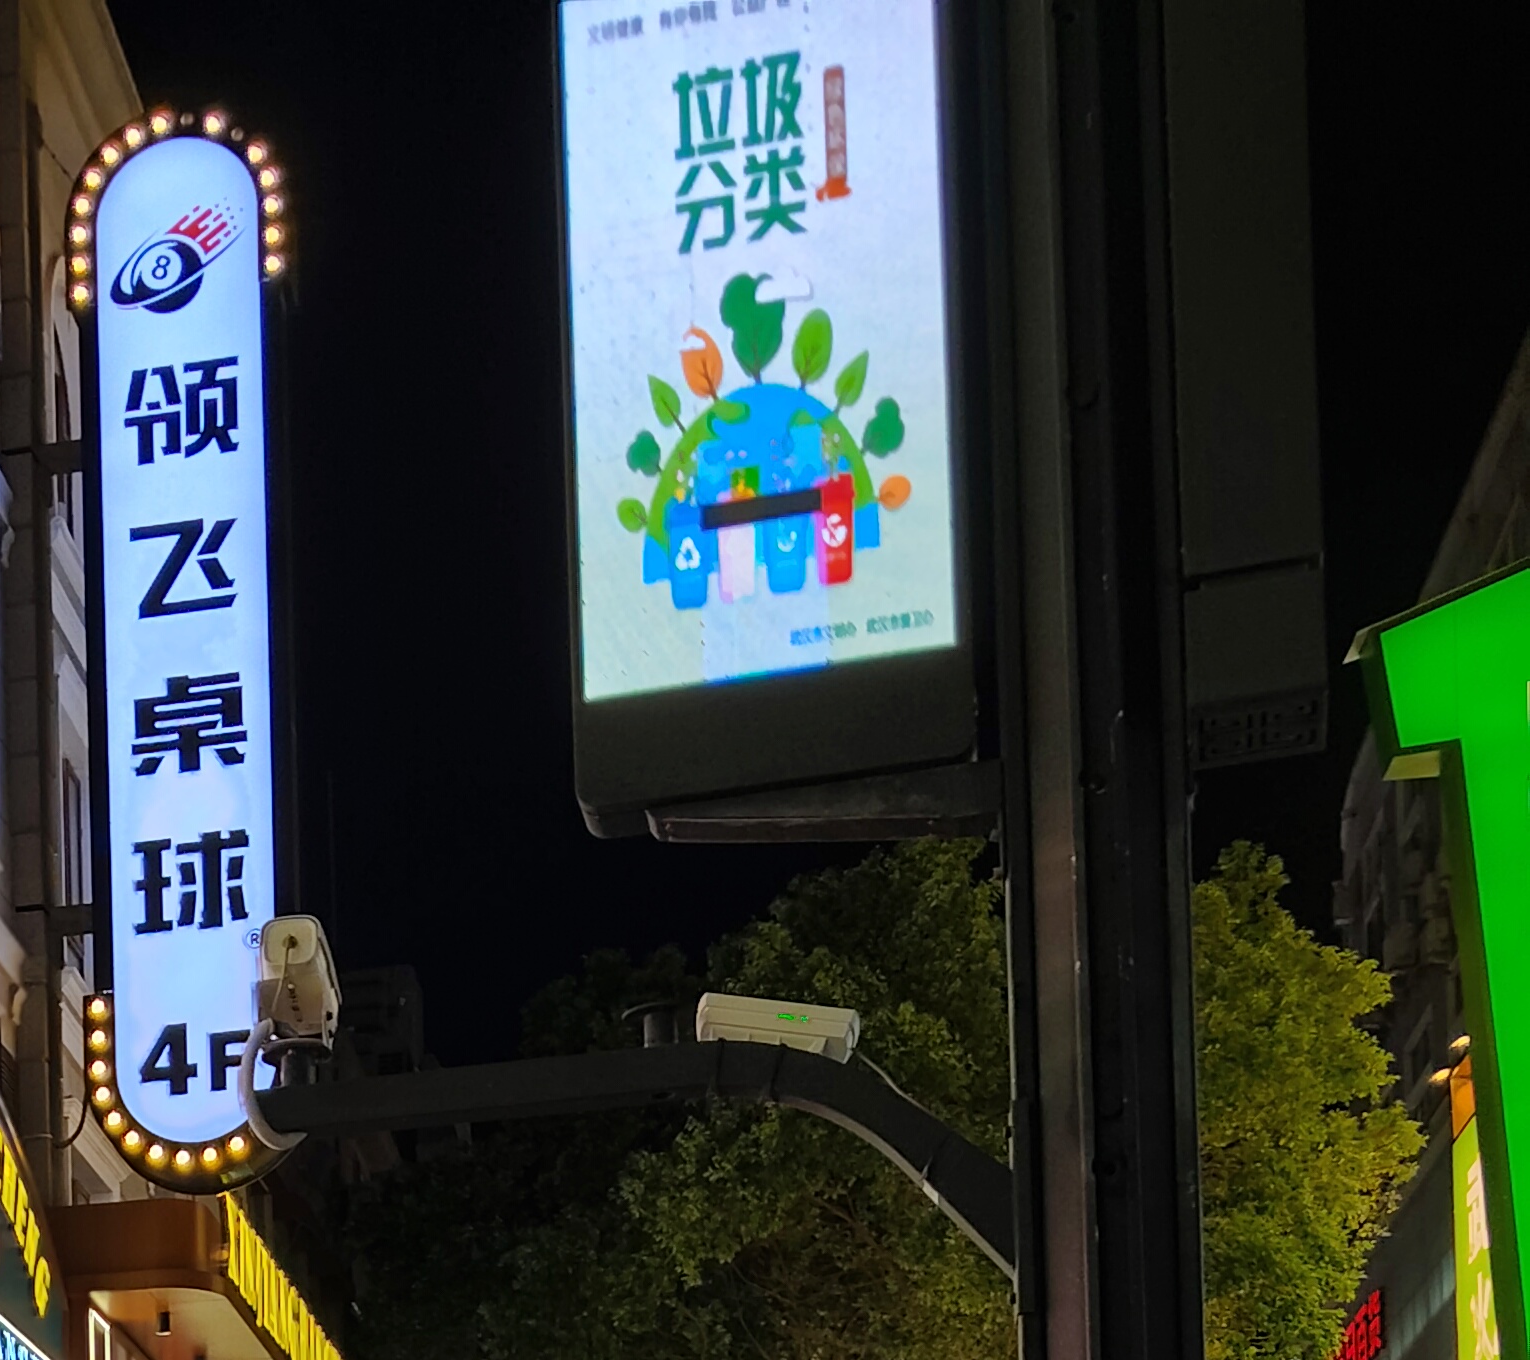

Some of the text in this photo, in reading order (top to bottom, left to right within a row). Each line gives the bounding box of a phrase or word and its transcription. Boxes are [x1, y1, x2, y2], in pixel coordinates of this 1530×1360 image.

[672, 50, 804, 161] 垃圾
[675, 145, 808, 255] 分类
[124, 355, 250, 936] 领飞桌球
[138, 1021, 253, 1097] 4F
